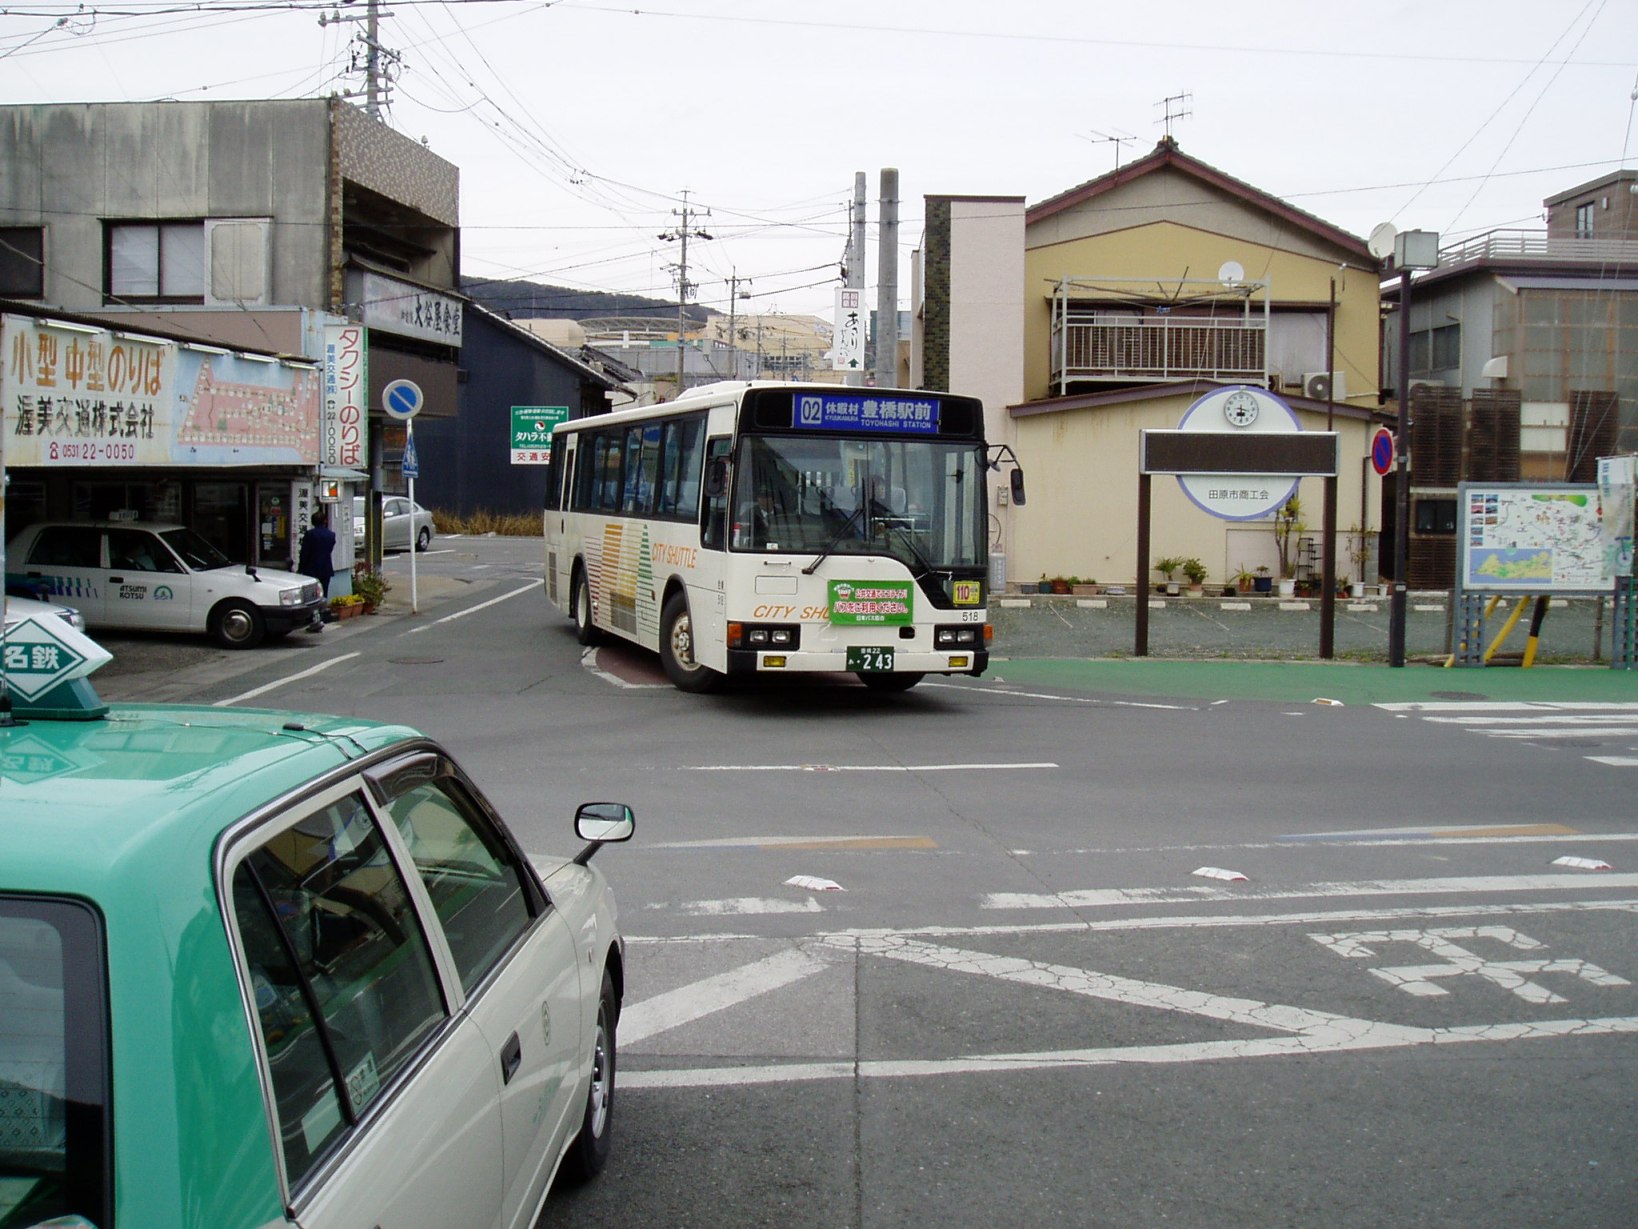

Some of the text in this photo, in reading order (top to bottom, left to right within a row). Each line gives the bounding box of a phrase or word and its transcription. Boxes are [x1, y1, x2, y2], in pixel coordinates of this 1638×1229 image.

[339, 329, 361, 466] タクシーのりば
[802, 399, 821, 422] 02
[861, 399, 931, 421] 豊橋駅前
[861, 419, 931, 428] TOYOHASHI STATION
[327, 411, 336, 465] 22-0050
[82, 443, 134, 460] 22-0050
[1208, 489, 1270, 501] 田原市商工会
[666, 545, 697, 569] SHUTTLE
[753, 605, 796, 619] CITY
[962, 611, 979, 622] 518
[4, 645, 60, 670] 名鉄
